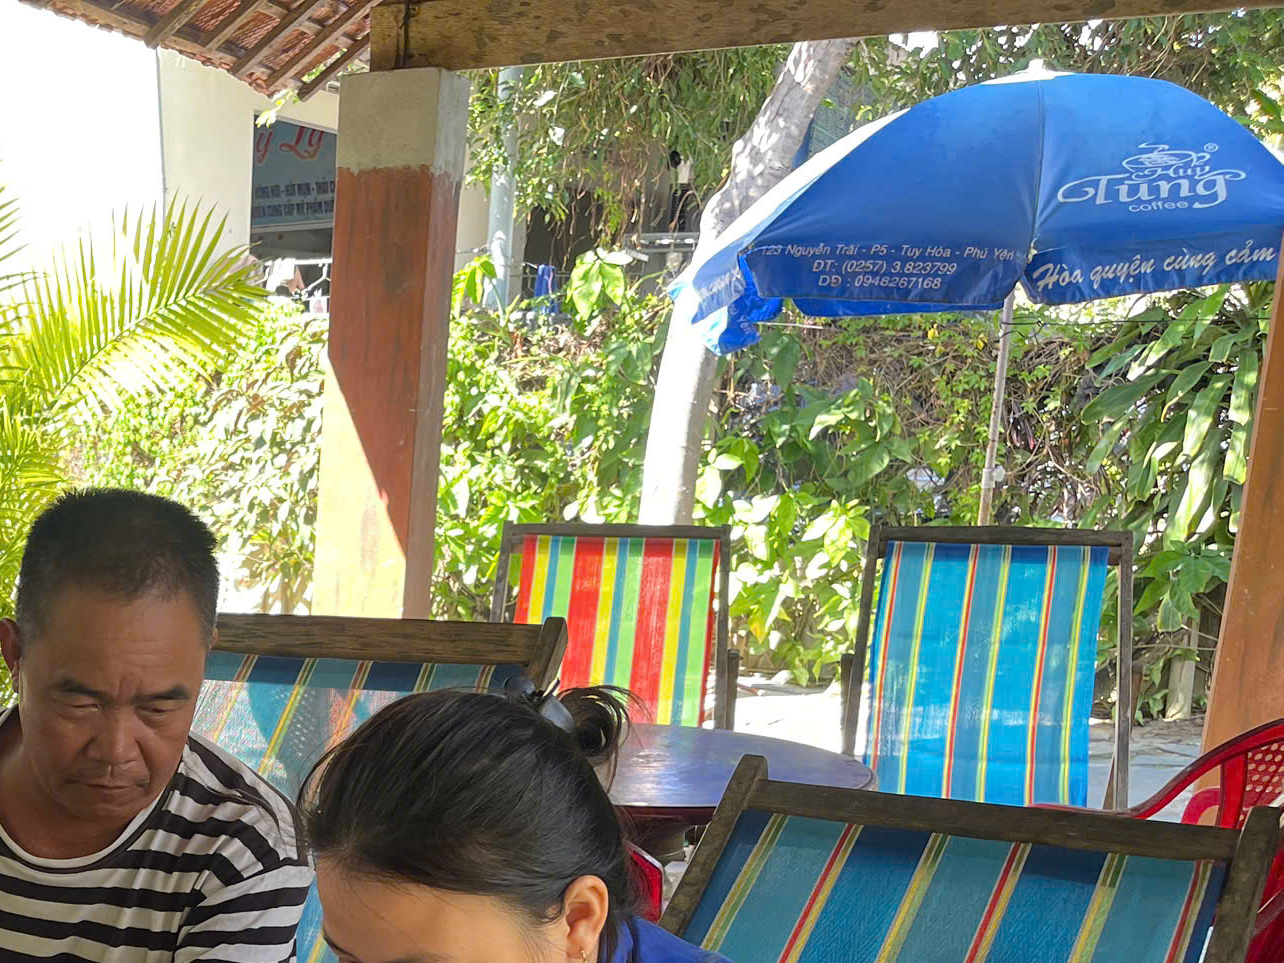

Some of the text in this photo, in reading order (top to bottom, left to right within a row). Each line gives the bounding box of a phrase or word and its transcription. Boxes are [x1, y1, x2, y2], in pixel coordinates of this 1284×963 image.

[1128, 201, 1189, 212] coffee
[870, 245, 888, 255] P5
[901, 245, 922, 258] Tuy
[925, 245, 951, 257] Hòa
[993, 248, 1014, 260] Yên
[842, 260, 887, 274] (0257)
[891, 261, 957, 274] 3.823799
[1033, 239, 1276, 291] Hòa quyện cùng cảm
[854, 275, 942, 289] 0948267168
